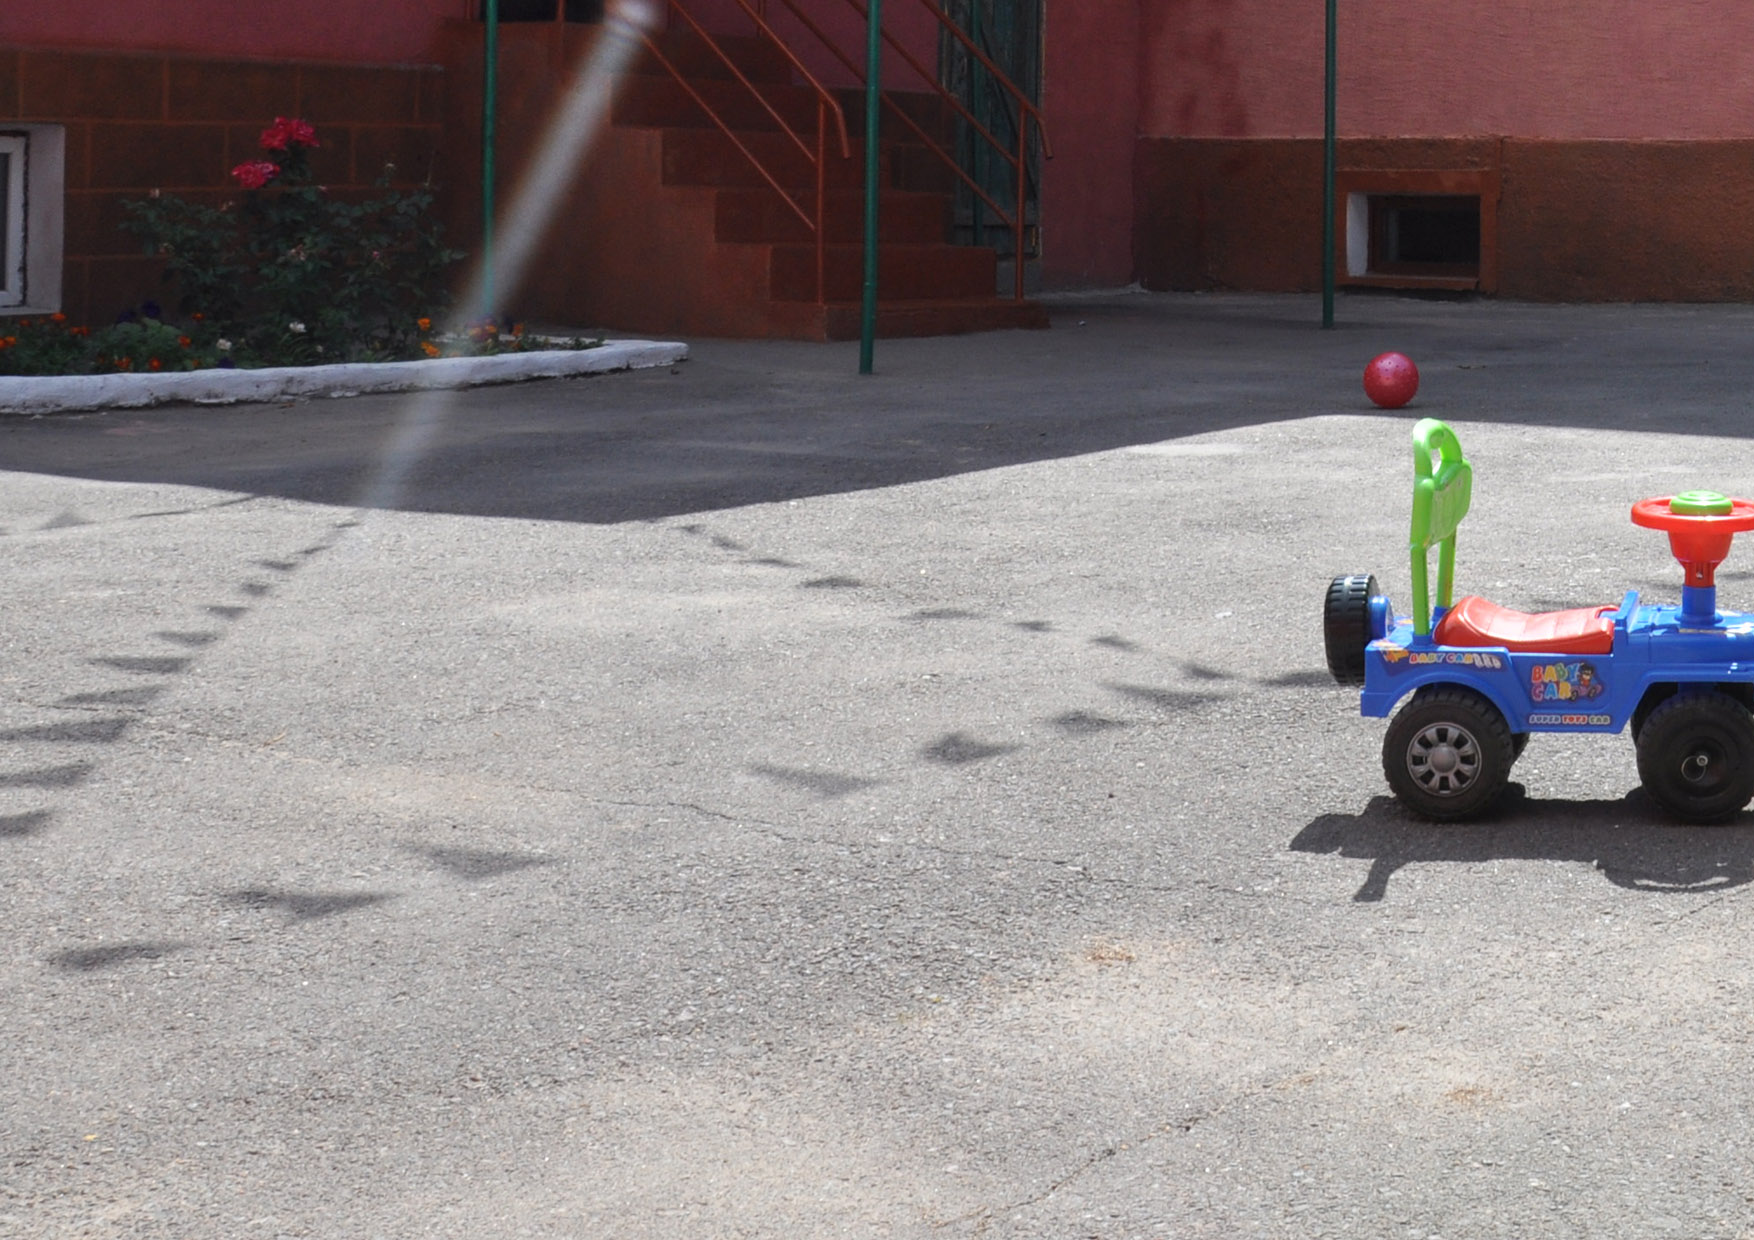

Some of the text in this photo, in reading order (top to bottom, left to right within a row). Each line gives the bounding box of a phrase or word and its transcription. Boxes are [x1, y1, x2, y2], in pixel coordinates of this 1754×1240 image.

[1531, 662, 1580, 684] BABY
[1531, 681, 1572, 702] CAR
[1562, 714, 1588, 725] TOYS
[1588, 715, 1611, 725] CAR
